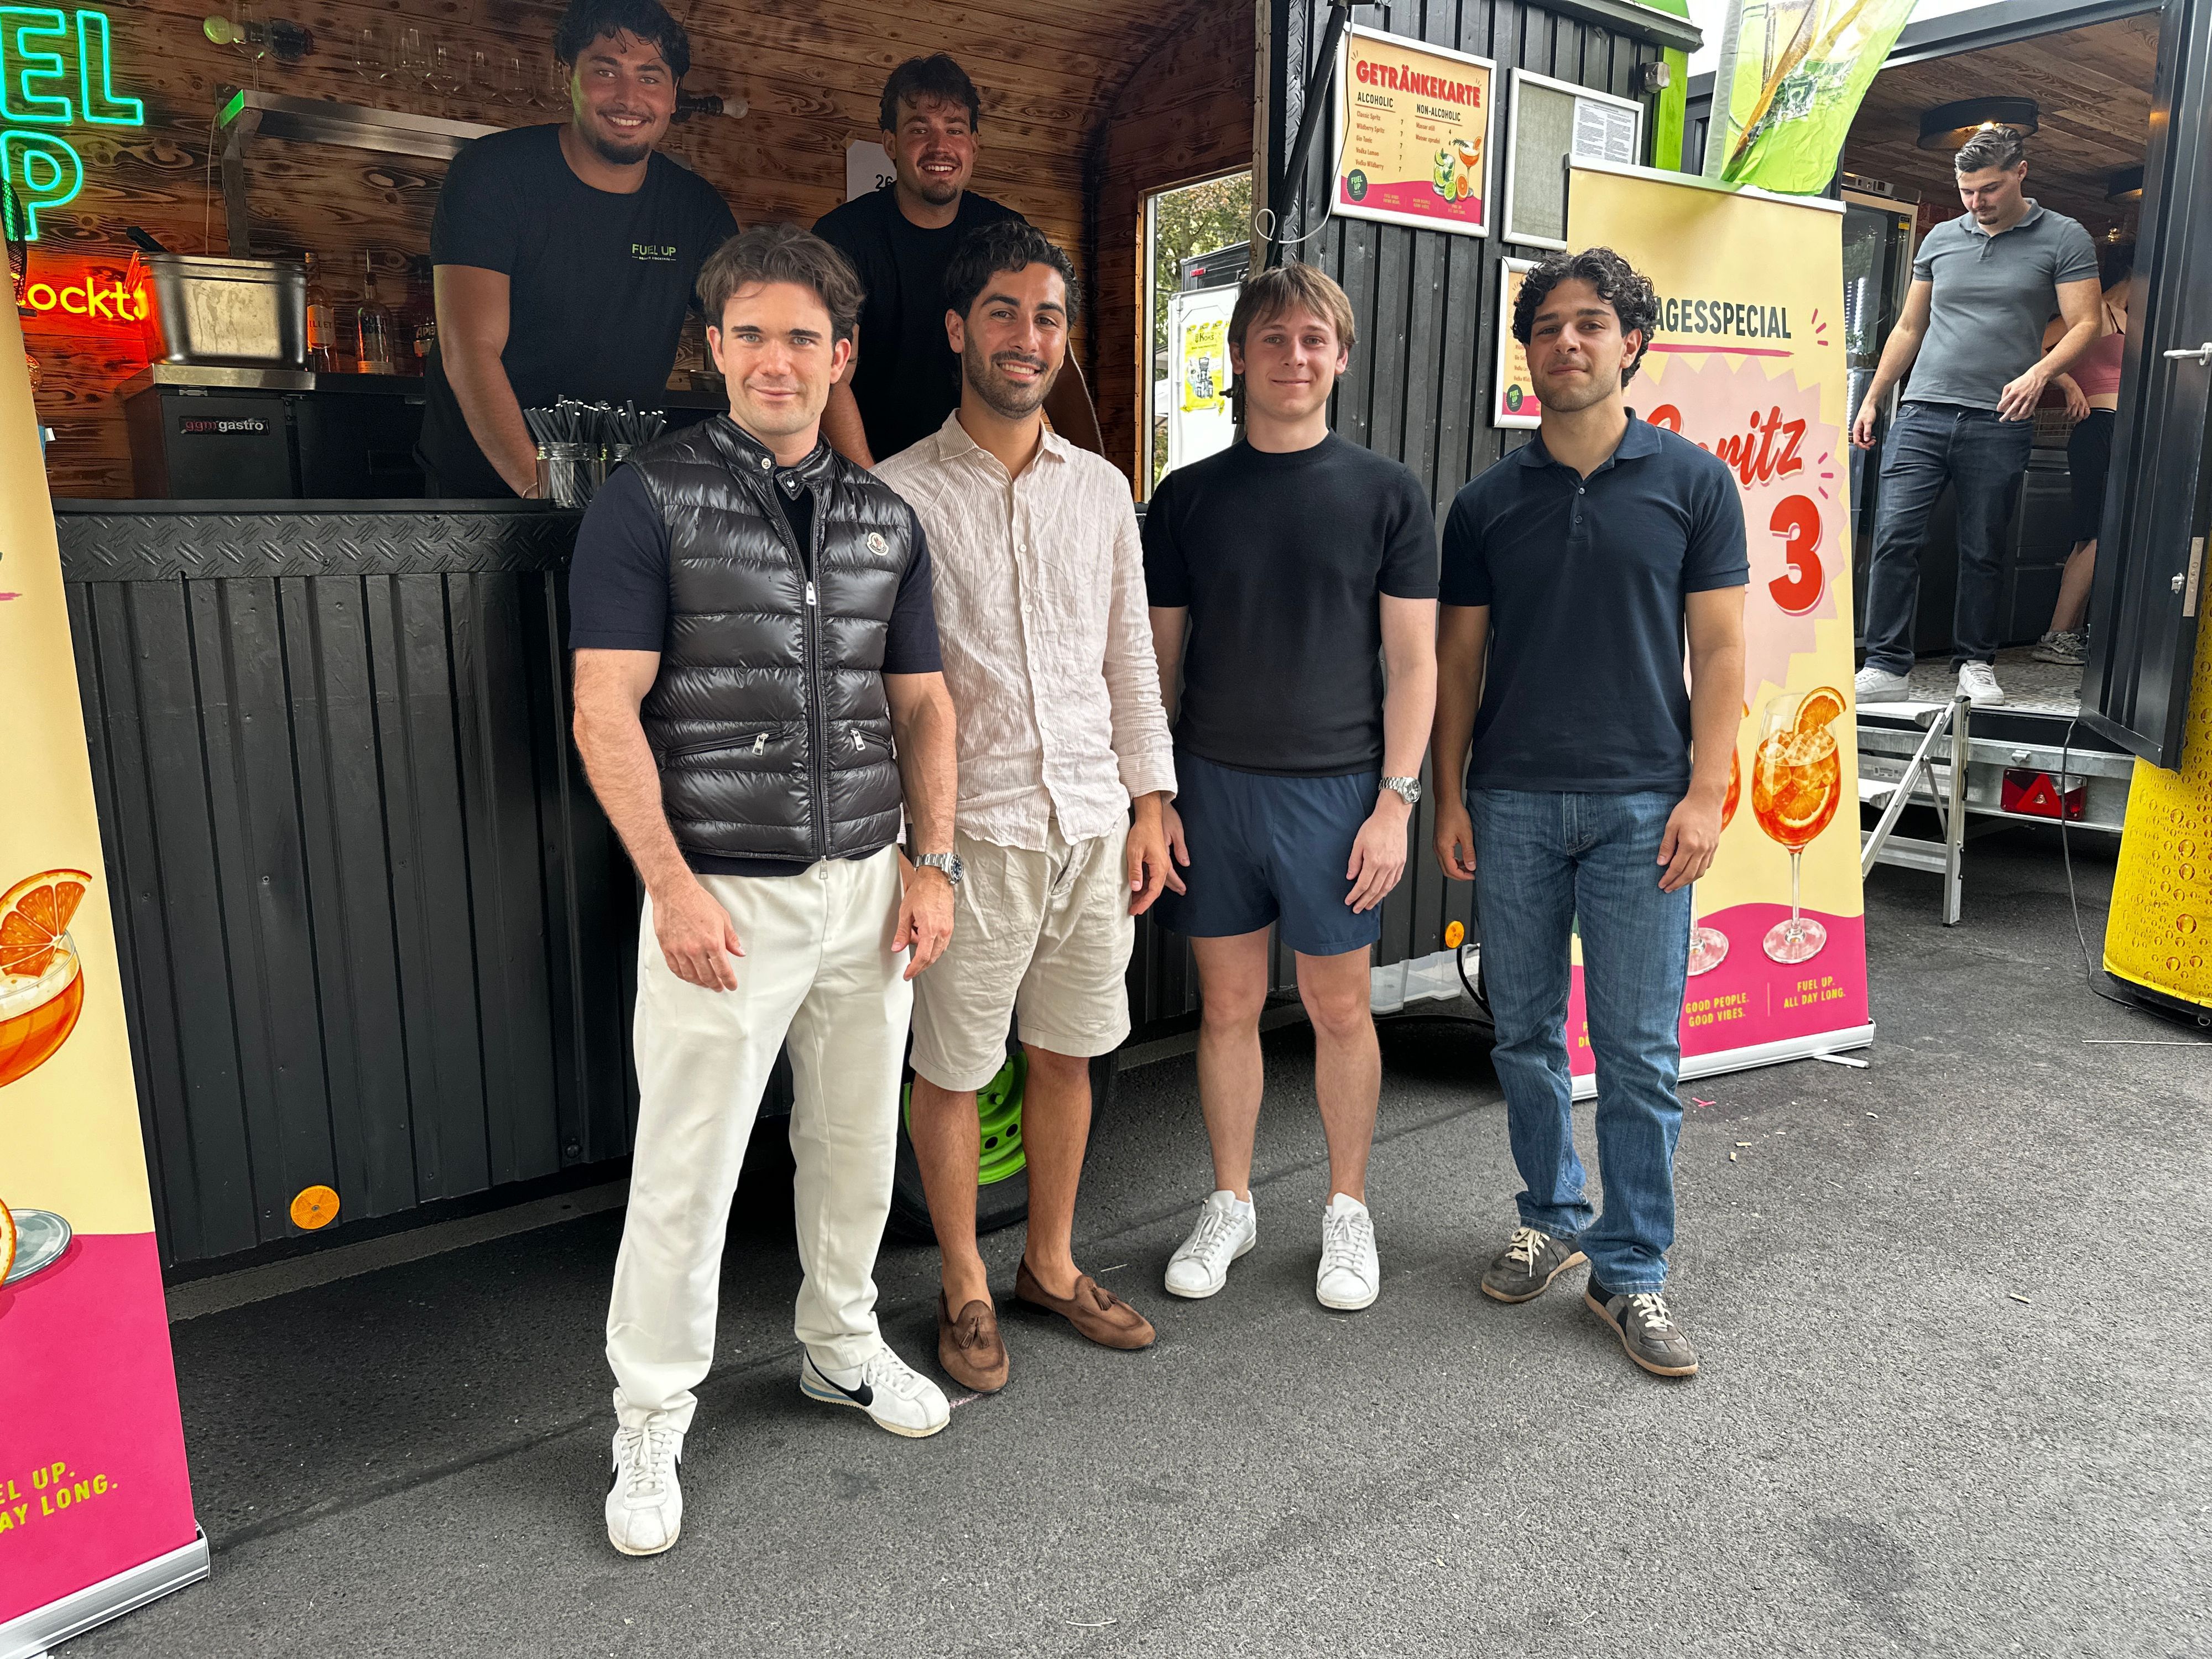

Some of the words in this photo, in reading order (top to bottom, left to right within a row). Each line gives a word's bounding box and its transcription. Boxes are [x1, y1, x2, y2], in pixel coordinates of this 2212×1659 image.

[1356, 60, 1481, 108] GETRÄNKEKARTE
[1357, 92, 1394, 108] ALCOHOLIC
[1416, 103, 1460, 122] NON-ALCOHOLIC
[1351, 175, 1363, 184] FUEL
[632, 243, 658, 255] FUEL
[661, 246, 676, 256] UP
[1654, 297, 1792, 339] AGESSPECIAL
[416, 326, 436, 338] APE
[1647, 404, 1808, 491] ritz
[1768, 494, 1825, 617] 3
[1797, 979, 1818, 992] FUEL
[1821, 976, 1835, 988] UP.
[1685, 999, 1710, 1014] GOOD
[1714, 993, 1750, 1009] PEOPLE.
[1783, 997, 1798, 1009] ALL
[1802, 992, 1819, 1005] DAY
[1821, 988, 1846, 1001] LONG.
[1689, 1013, 1714, 1027] GOOD
[1717, 1007, 1746, 1022] VIBES.
[32, 1461, 76, 1490] UP.
[40, 1473, 118, 1517] LONG.
